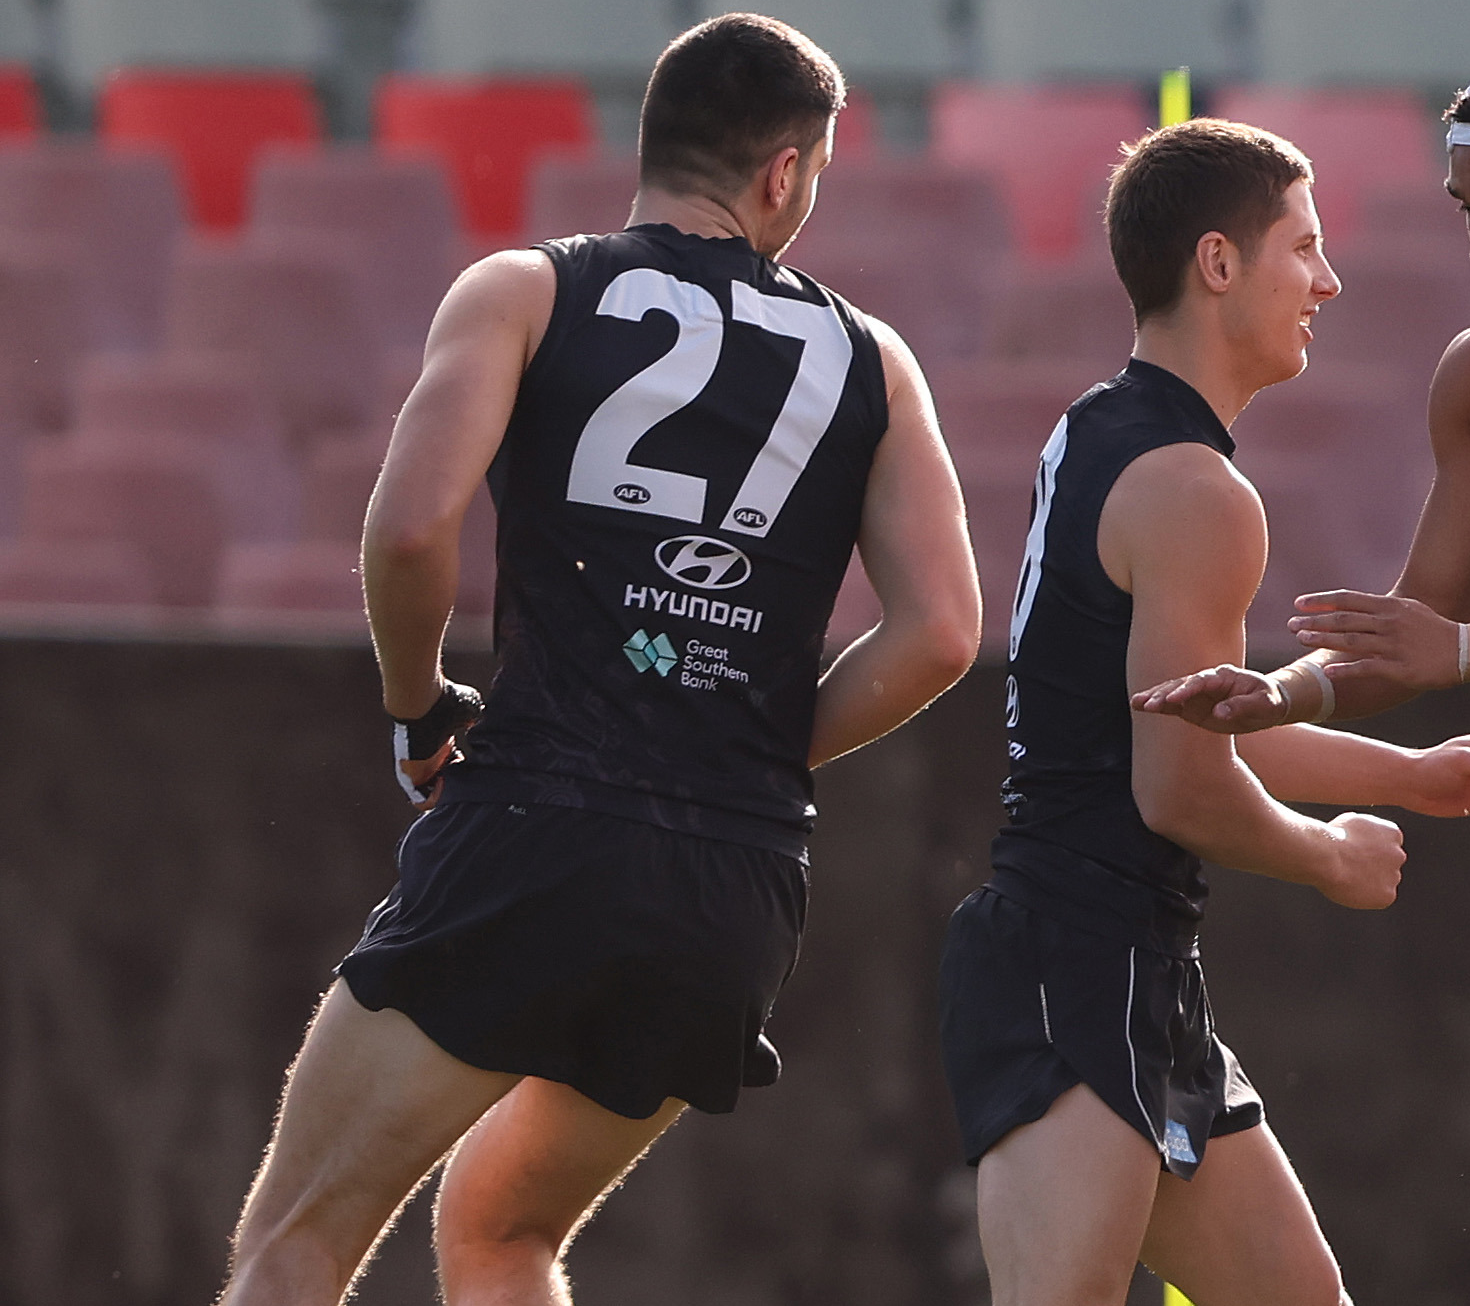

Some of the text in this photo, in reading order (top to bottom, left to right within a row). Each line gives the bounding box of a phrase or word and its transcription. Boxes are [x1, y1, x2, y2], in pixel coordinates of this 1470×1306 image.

[566, 268, 853, 538] 27
[615, 486, 649, 502] AFL
[734, 510, 766, 527] AFL
[623, 583, 763, 633] HYUNDAI
[686, 639, 730, 662] Great
[680, 671, 719, 692] Bank
[682, 656, 749, 684] Southern
